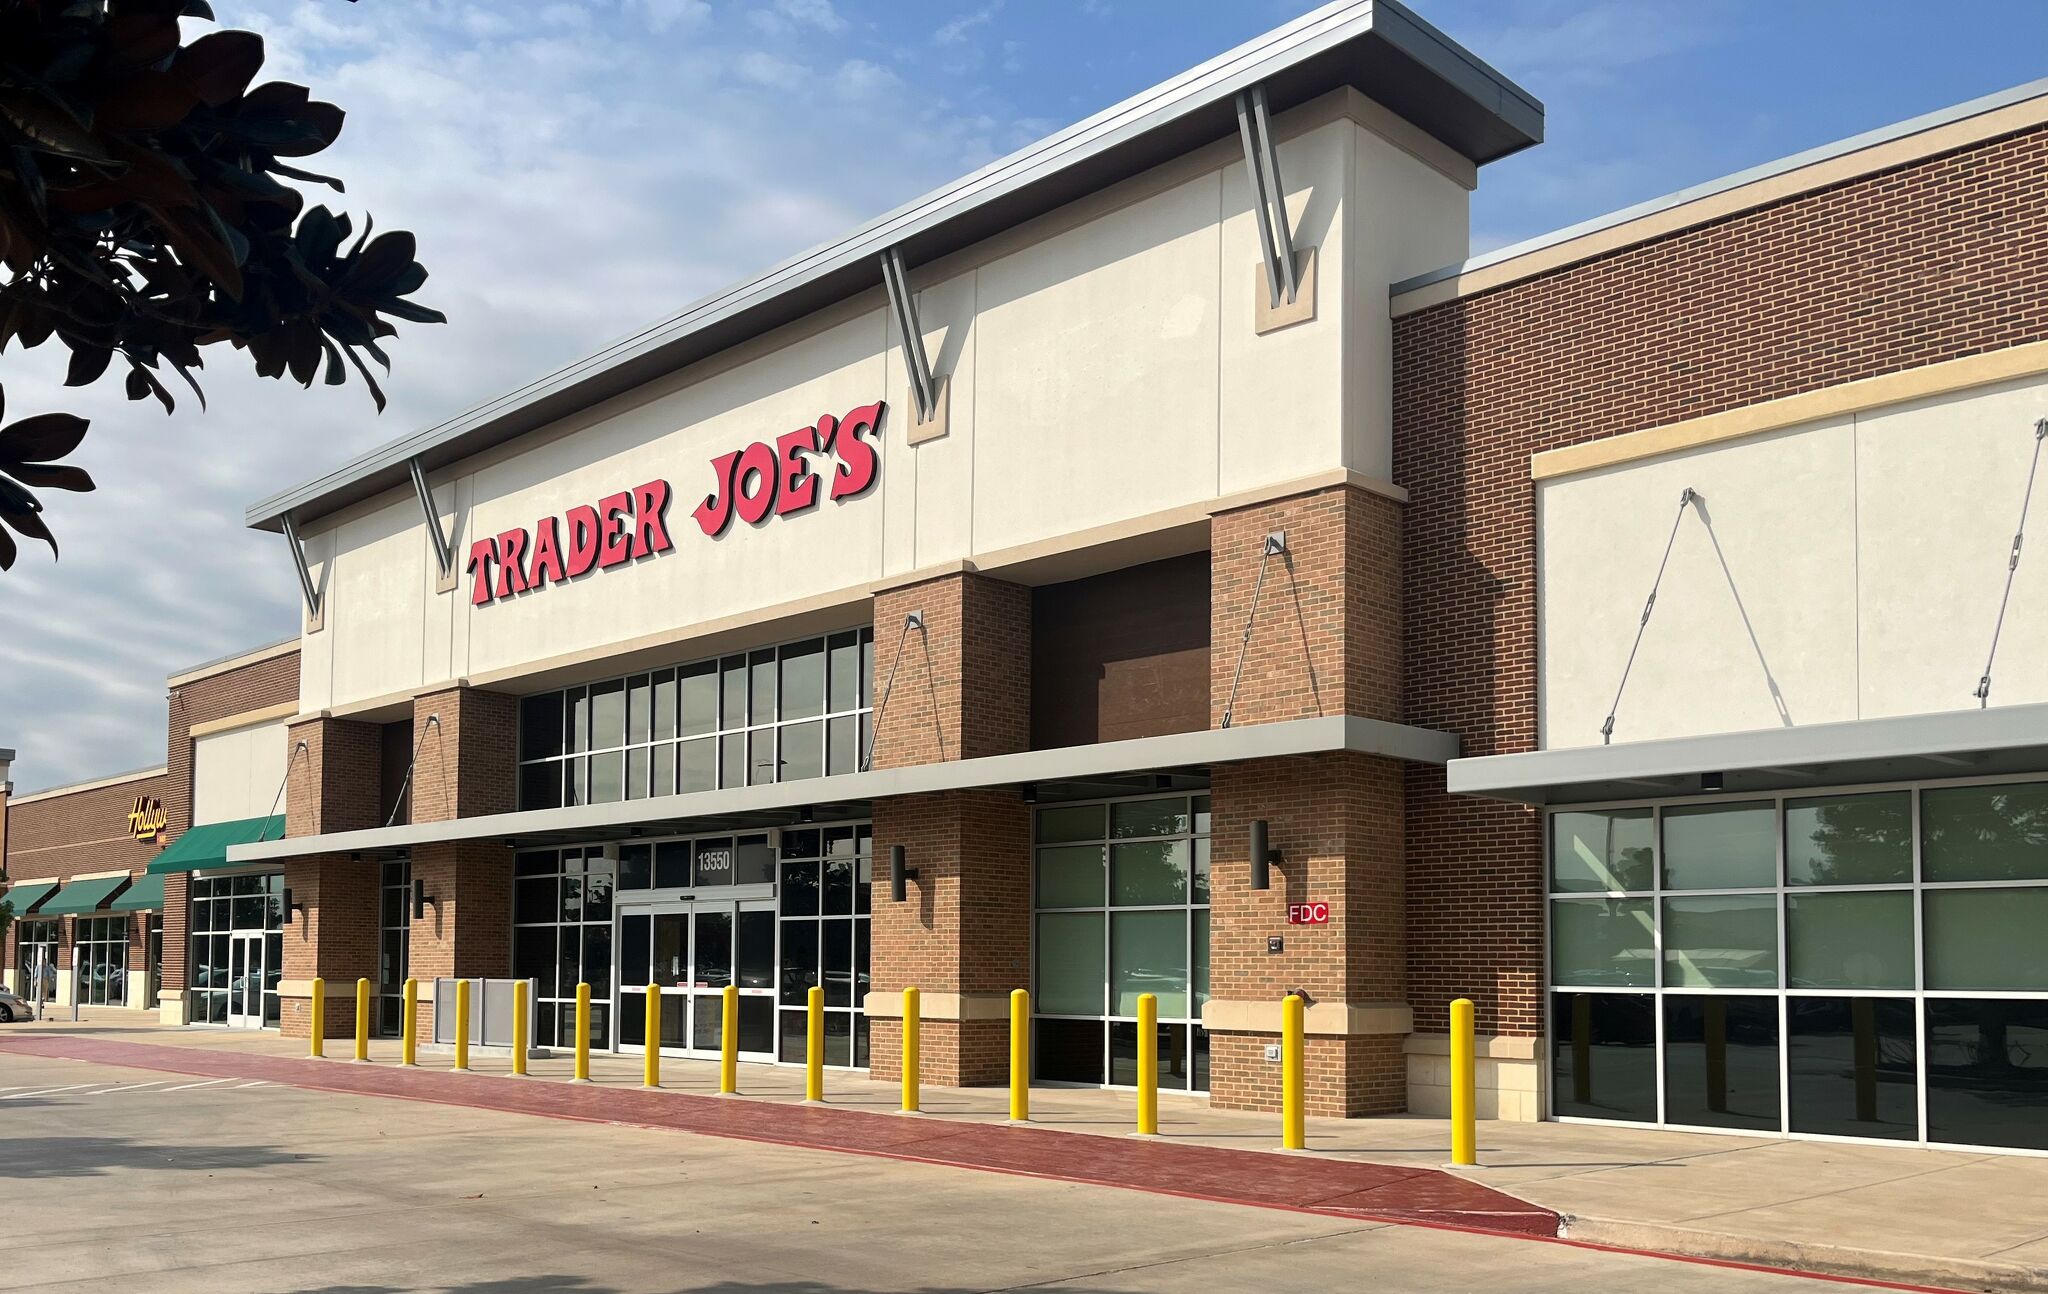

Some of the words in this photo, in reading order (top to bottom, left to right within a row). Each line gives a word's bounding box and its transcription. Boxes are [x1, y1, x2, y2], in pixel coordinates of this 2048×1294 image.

[466, 478, 674, 606] TRADER
[690, 400, 887, 537] JOE'S
[698, 850, 730, 871] 13550
[1289, 904, 1327, 922] FDC
